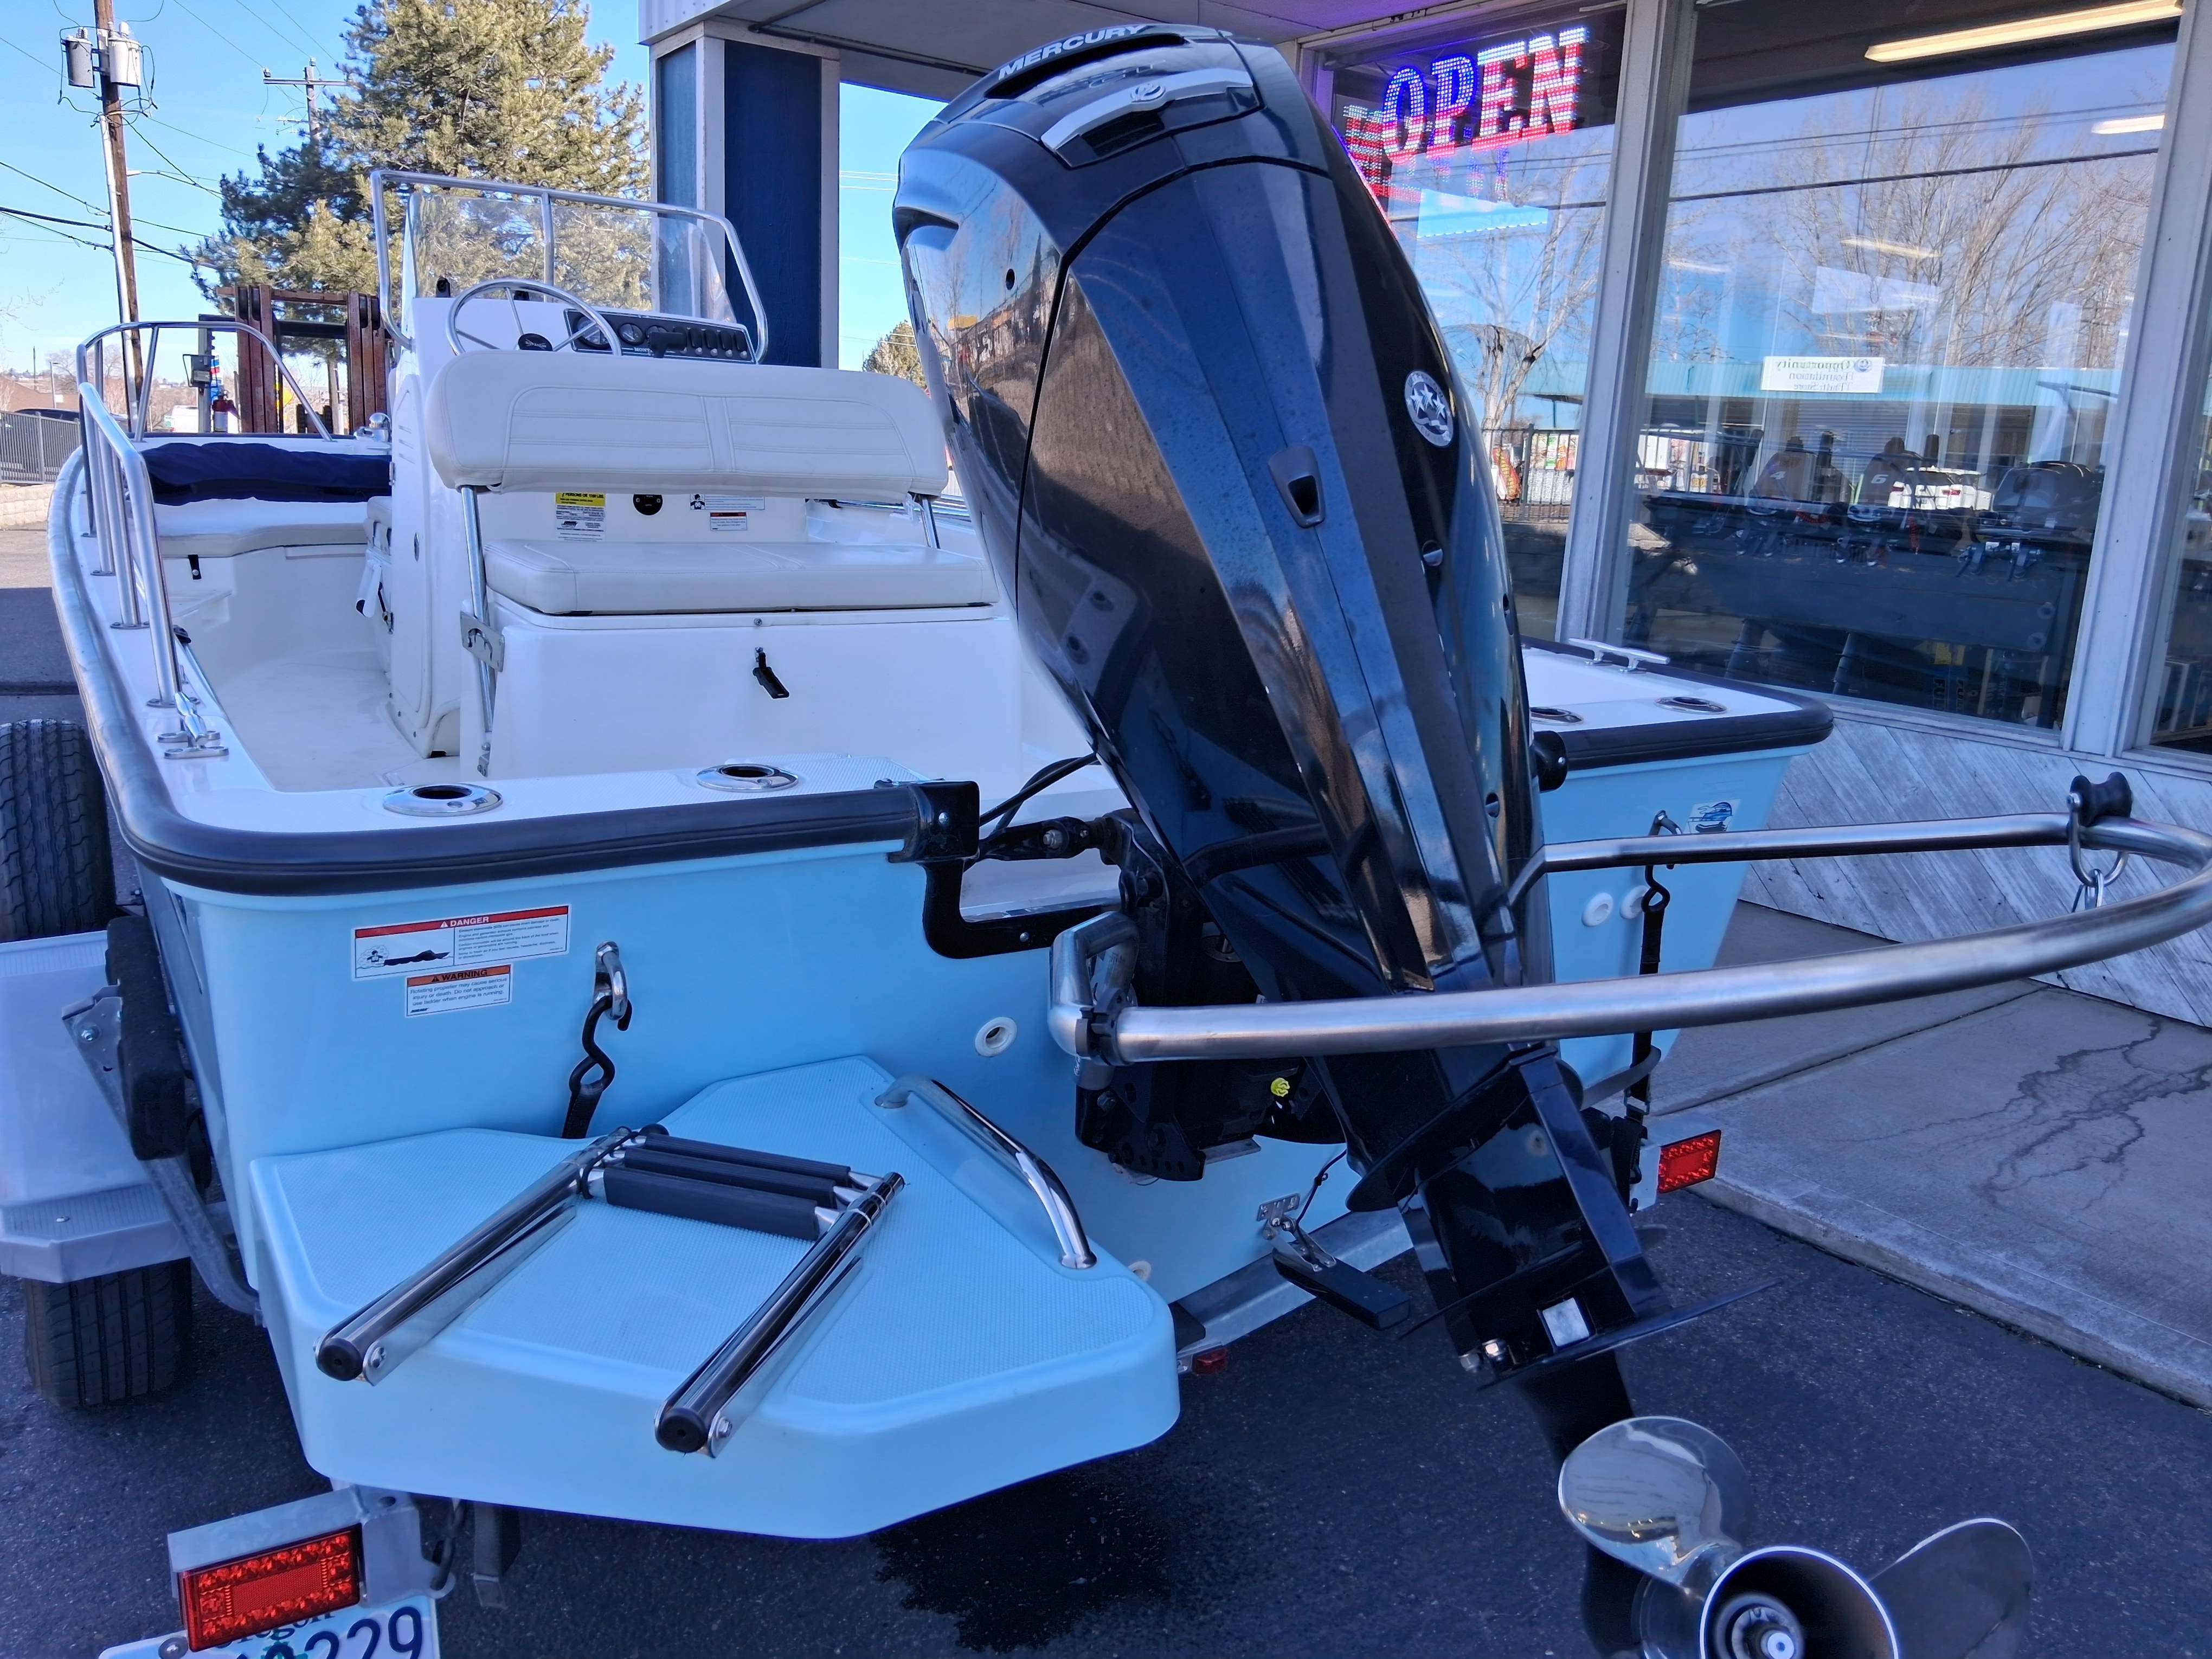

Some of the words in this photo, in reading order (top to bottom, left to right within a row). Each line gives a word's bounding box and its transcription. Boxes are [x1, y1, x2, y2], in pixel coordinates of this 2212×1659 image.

[998, 25, 1144, 80] MERCURY
[1382, 26, 1589, 165] OPEN
[1770, 471, 1786, 479] 4
[1871, 474, 1888, 484] 6
[450, 916, 489, 927] DANGER
[442, 969, 487, 981] WARNING
